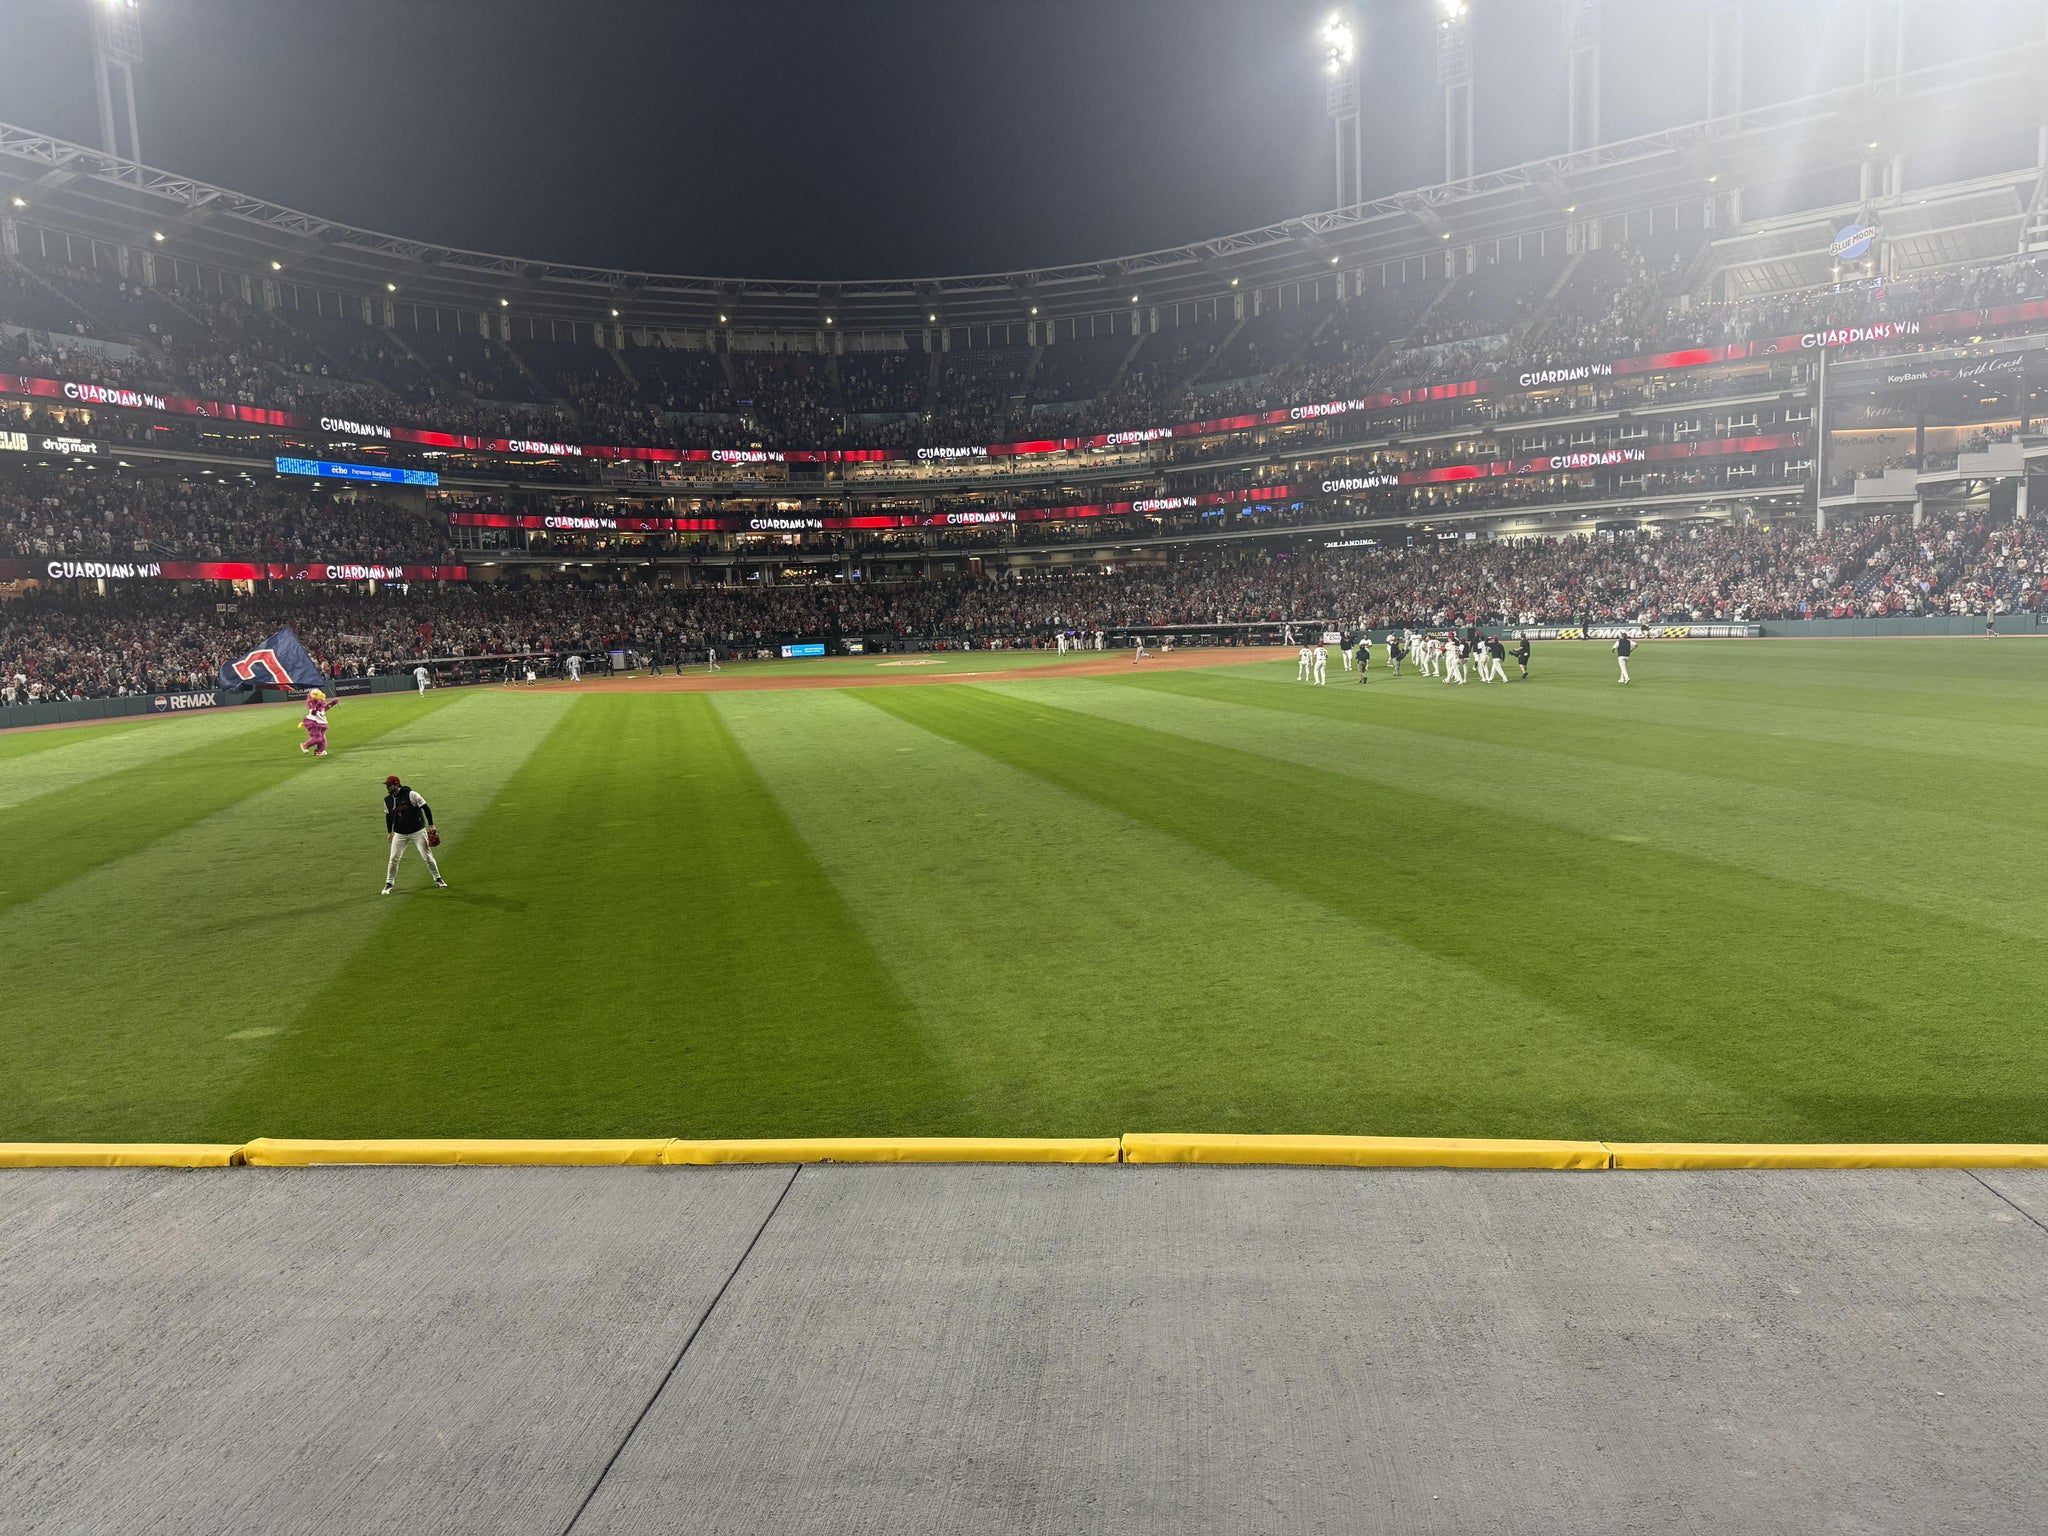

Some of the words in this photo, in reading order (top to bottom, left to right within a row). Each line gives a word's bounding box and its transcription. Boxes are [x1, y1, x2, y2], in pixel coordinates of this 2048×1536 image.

[1830, 239, 1851, 254] BLUE
[1852, 228, 1874, 243] MOON
[1801, 322, 1890, 348] GUARDIANS
[1893, 321, 1920, 334] WIN
[1519, 366, 1590, 387] GUARDIANS
[1591, 364, 1611, 375] WIN
[1951, 361, 1987, 380] North
[1988, 355, 2023, 371] Coast
[1888, 372, 1928, 383] KeyBank
[64, 382, 142, 408] GUARDIANS
[143, 393, 165, 410] WIN
[1291, 402, 1346, 419] GUARDIANS
[1348, 400, 1364, 409] WIN
[321, 417, 374, 436] GUARDIANS
[376, 425, 391, 438] WIN
[1107, 429, 1158, 444] GUARDIANS
[1159, 428, 1172, 437] WIN
[42, 438, 69, 454] drug
[70, 443, 97, 453] mart
[509, 440, 564, 454] GUARDIANS
[566, 445, 581, 455] WIN
[918, 447, 970, 459] GUARDIANS
[972, 446, 987, 458] WIN
[712, 450, 767, 462] GUARDIANS
[768, 452, 784, 461] WIN
[1550, 451, 1621, 468] GUARDIANS
[1624, 449, 1644, 460] WIN
[331, 465, 348, 474] echo
[1322, 476, 1380, 492] GUARDIANS
[1381, 475, 1398, 485] WIN
[1133, 498, 1181, 511] GUARDIANS
[1183, 497, 1196, 506] WIN
[545, 517, 599, 528] GUARDIANS
[600, 518, 616, 528] WIN
[751, 519, 805, 529] GUARDIANS
[806, 519, 822, 528] WIN
[947, 512, 999, 523] GUARDIANS
[1000, 511, 1016, 521] WIN
[48, 562, 134, 580] GUARDIANS
[137, 563, 161, 577] WIN
[326, 565, 385, 580] GUARDIANS
[386, 566, 403, 578] WIN
[170, 693, 216, 709] REMAX
